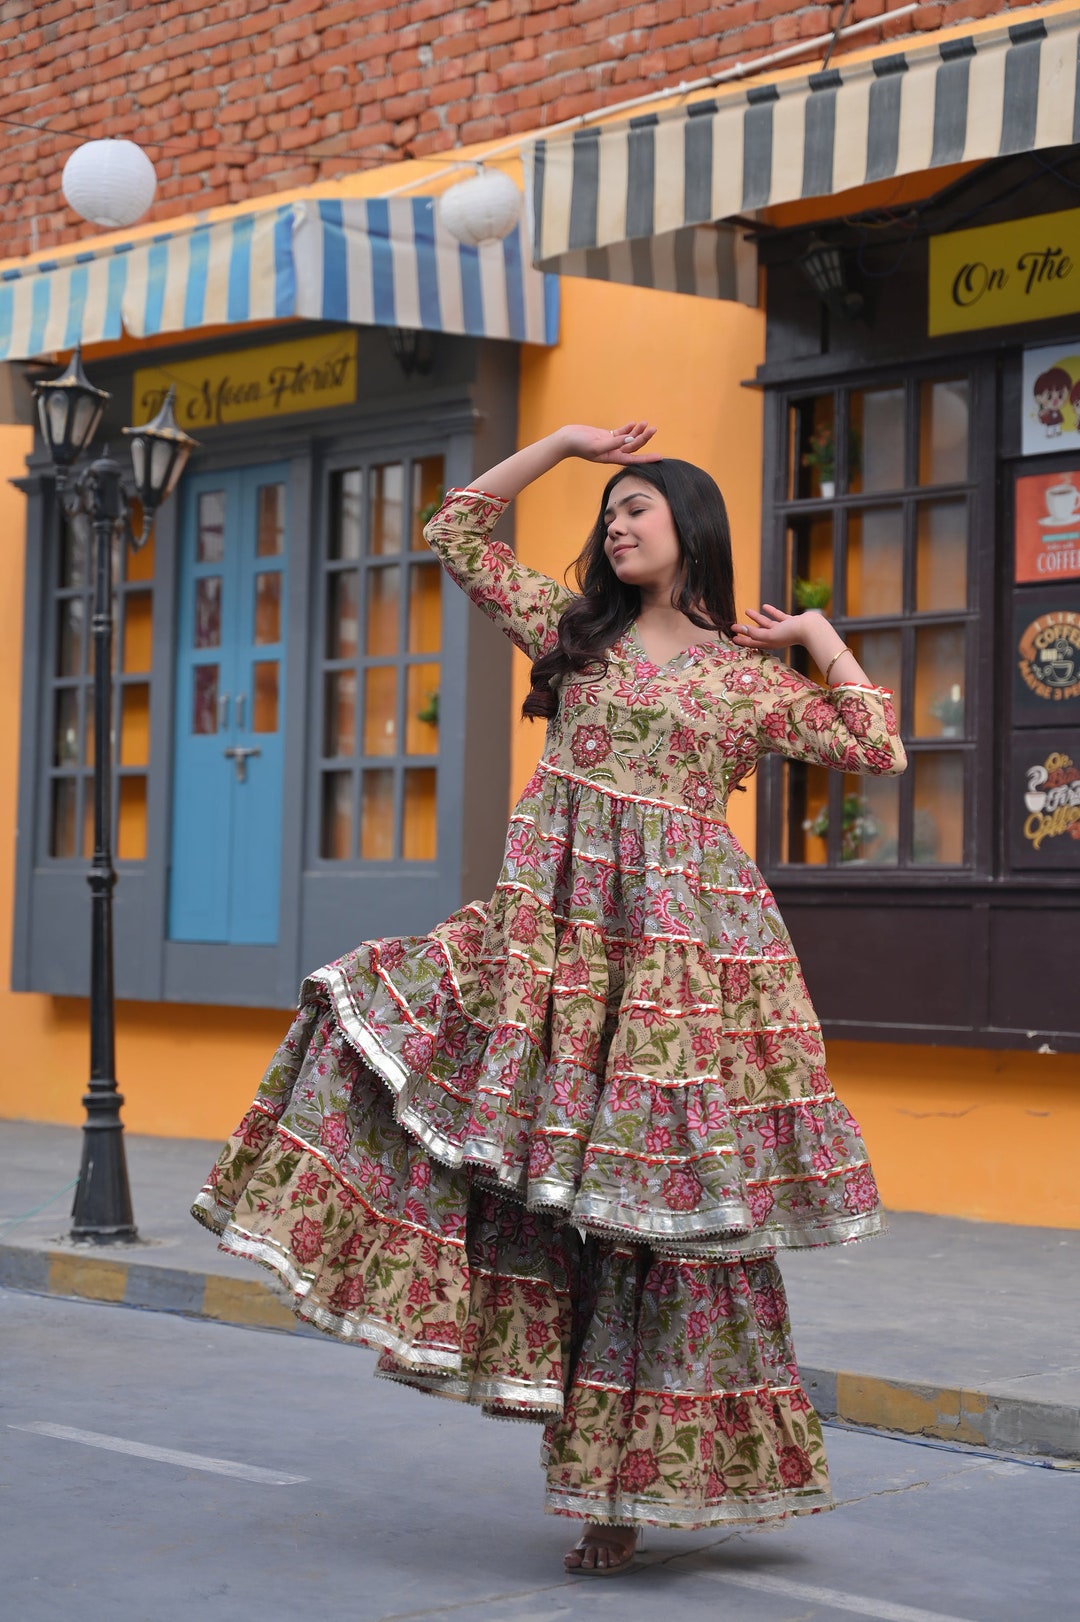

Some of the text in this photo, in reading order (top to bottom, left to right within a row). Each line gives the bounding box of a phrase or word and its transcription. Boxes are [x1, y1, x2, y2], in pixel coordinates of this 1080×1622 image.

[952, 247, 1073, 307] On The
[187, 376, 262, 423] Moon
[268, 354, 352, 407] Florist
[1046, 611, 1080, 627] LIK
[1024, 804, 1080, 850] Coffe
